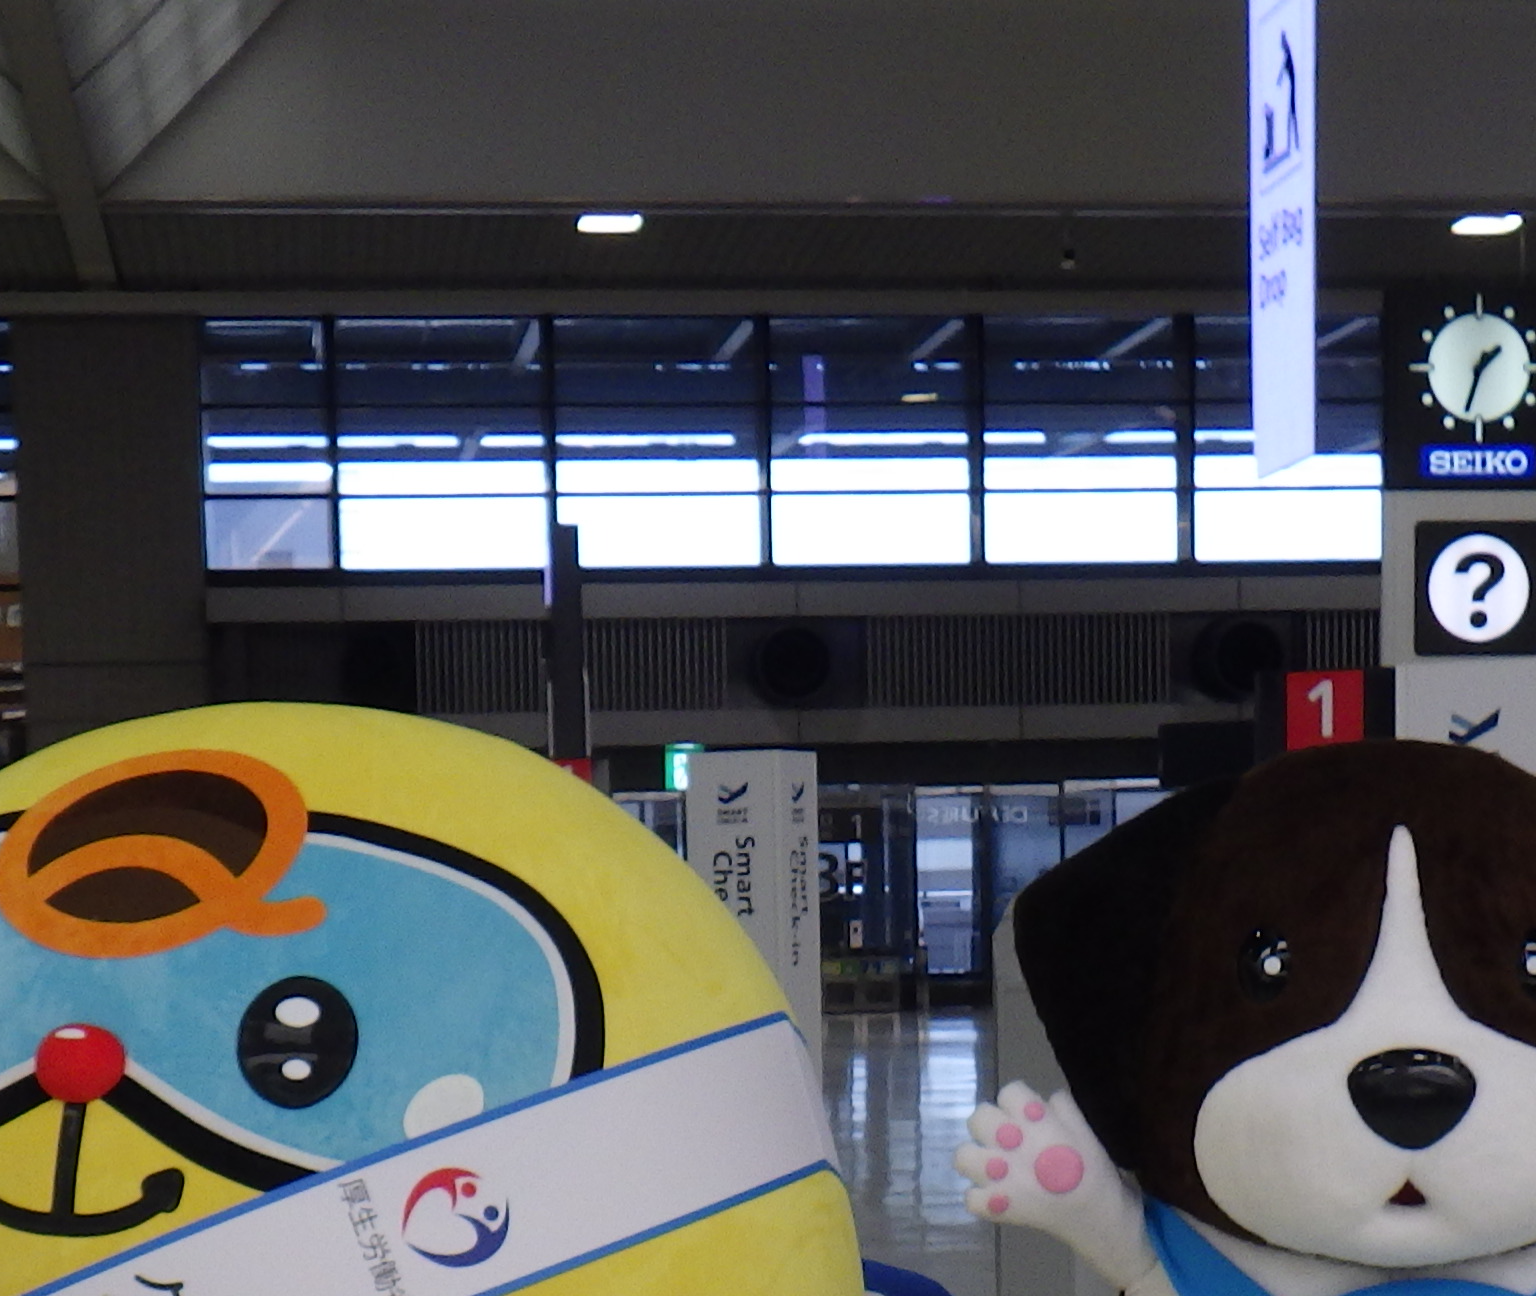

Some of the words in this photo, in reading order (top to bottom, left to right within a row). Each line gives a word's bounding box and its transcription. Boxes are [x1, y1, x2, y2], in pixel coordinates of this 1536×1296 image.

[1428, 450, 1529, 476] SEIKO
[1307, 679, 1335, 740] 1
[713, 851, 735, 902] Che
[735, 836, 756, 918] Smart
